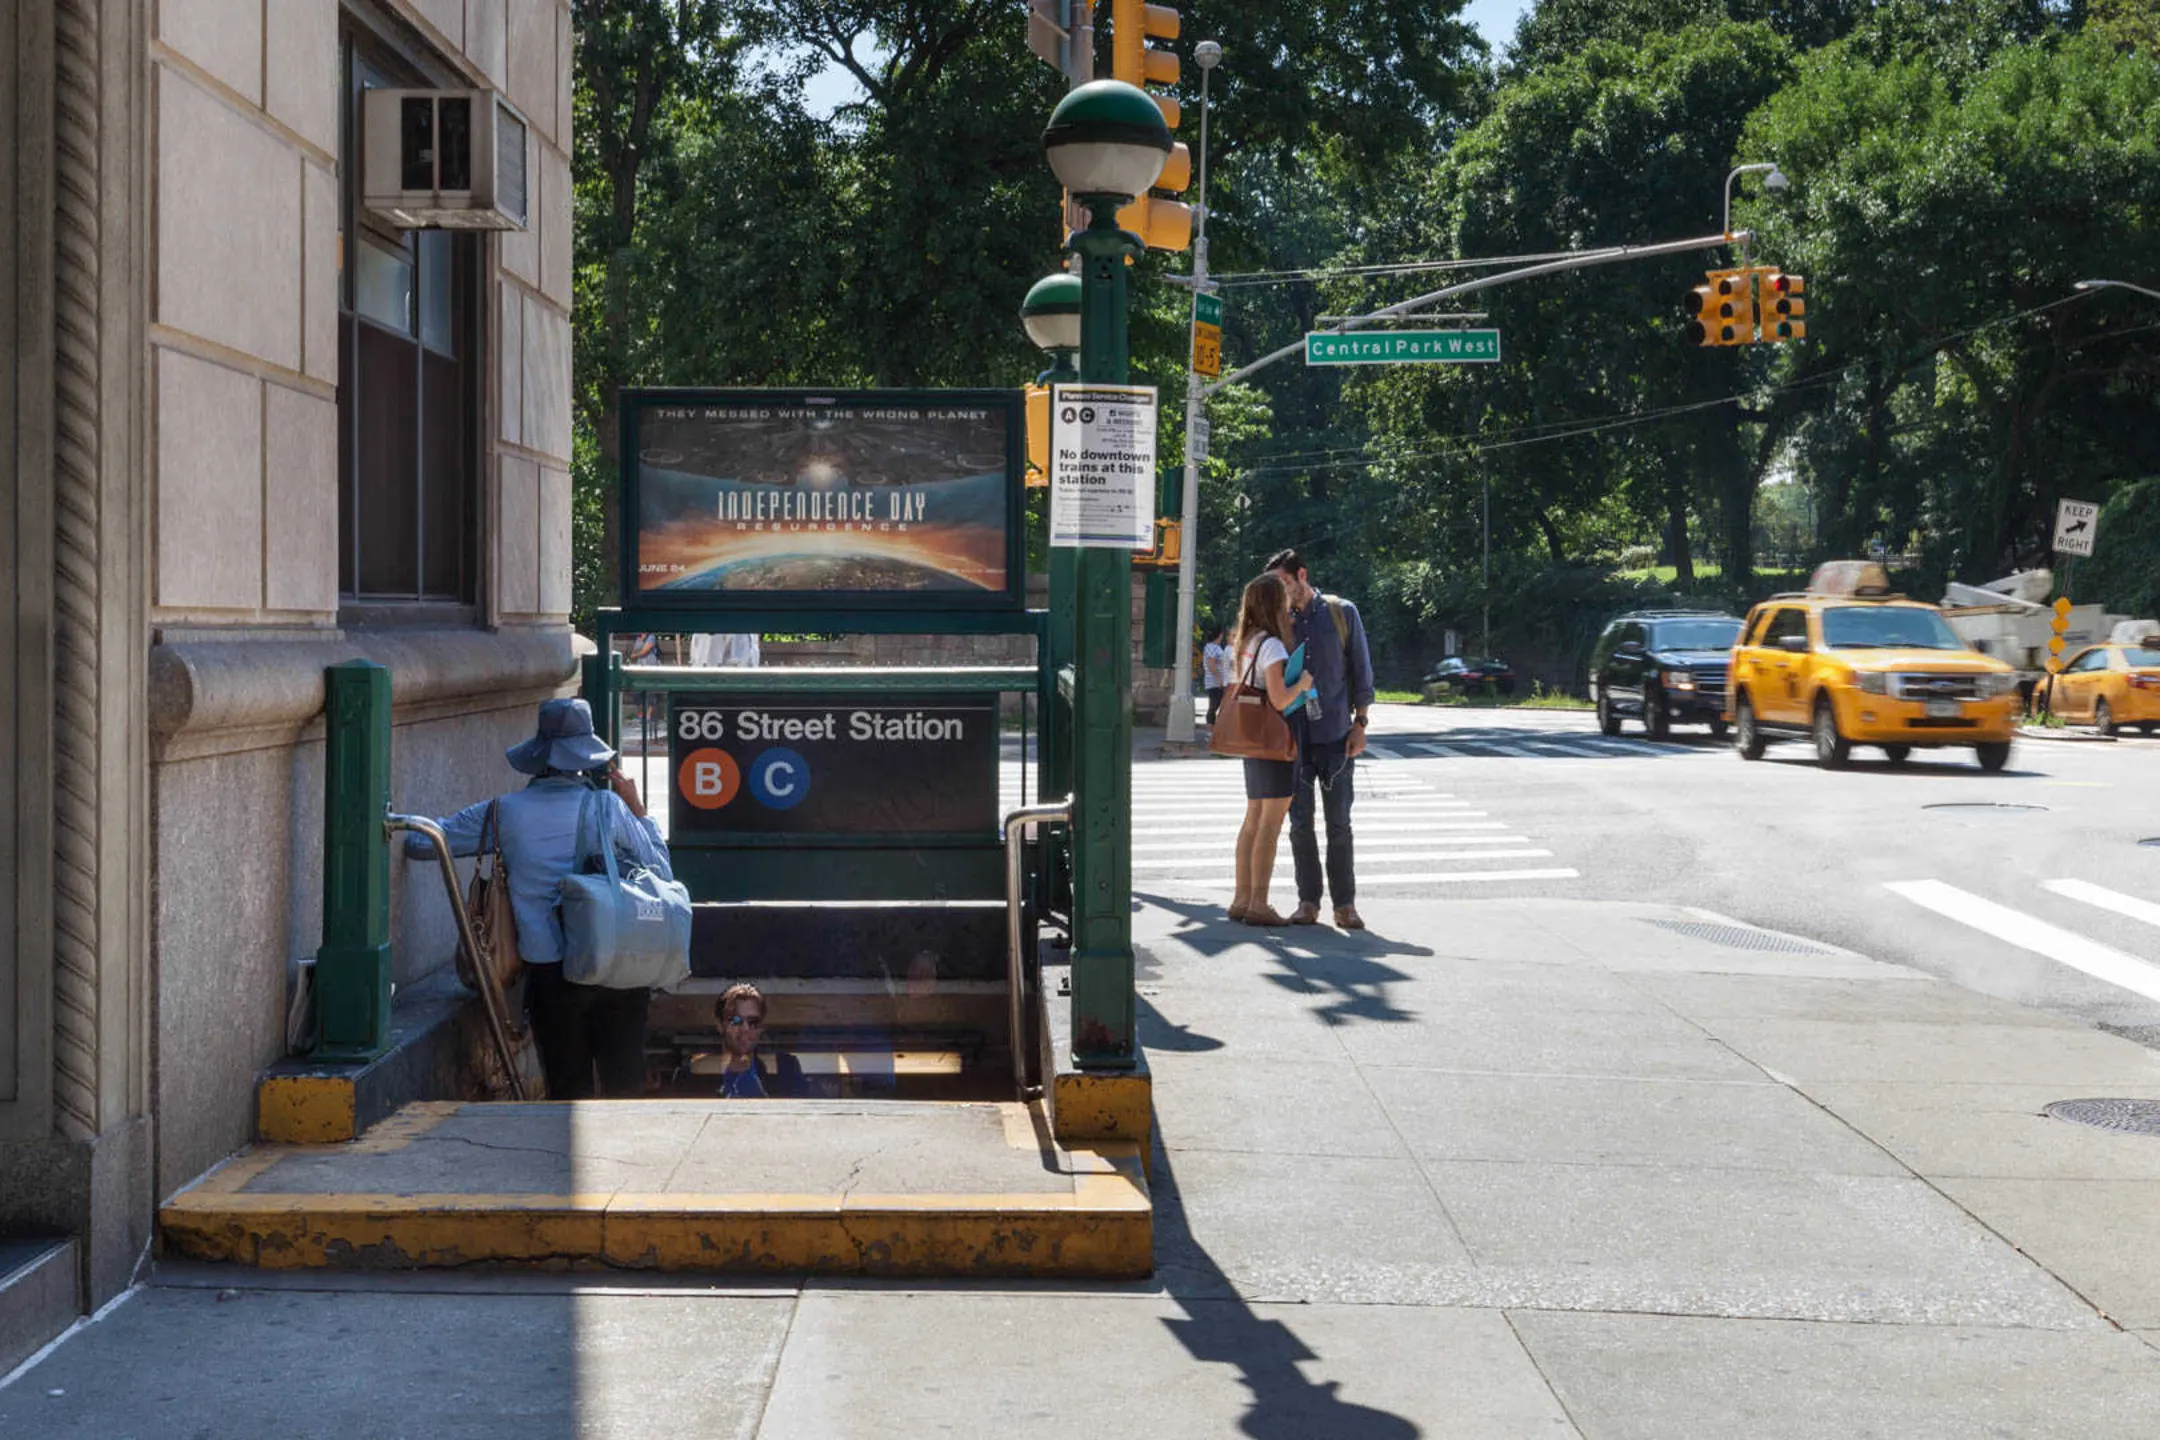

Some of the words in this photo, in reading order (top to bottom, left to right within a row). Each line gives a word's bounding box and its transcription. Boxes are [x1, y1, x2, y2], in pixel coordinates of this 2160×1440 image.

[1311, 340, 1390, 356] Central
[1396, 339, 1443, 354] Park
[1448, 338, 1495, 353] West
[657, 409, 697, 419] THEY
[704, 409, 771, 419] MESSED
[778, 409, 817, 419] WITH
[825, 410, 854, 419] THE
[862, 410, 920, 420] WRONG
[927, 410, 989, 420] PLANET
[1059, 449, 1077, 460] No
[1080, 449, 1151, 462] downtown
[1059, 461, 1099, 473] trains
[1101, 462, 1116, 473] at
[1119, 462, 1144, 474] this
[1058, 473, 1107, 485] station
[718, 491, 874, 521] INDEPENDENCE
[890, 491, 926, 522] DAY
[2064, 505, 2093, 518] KEEP
[736, 522, 909, 532] RESURGENCE
[2057, 536, 2090, 551] RIGHT
[678, 711, 724, 741] 86
[736, 711, 836, 741] Street
[849, 711, 964, 741] Station
[694, 762, 723, 796] B
[763, 761, 796, 797] C
